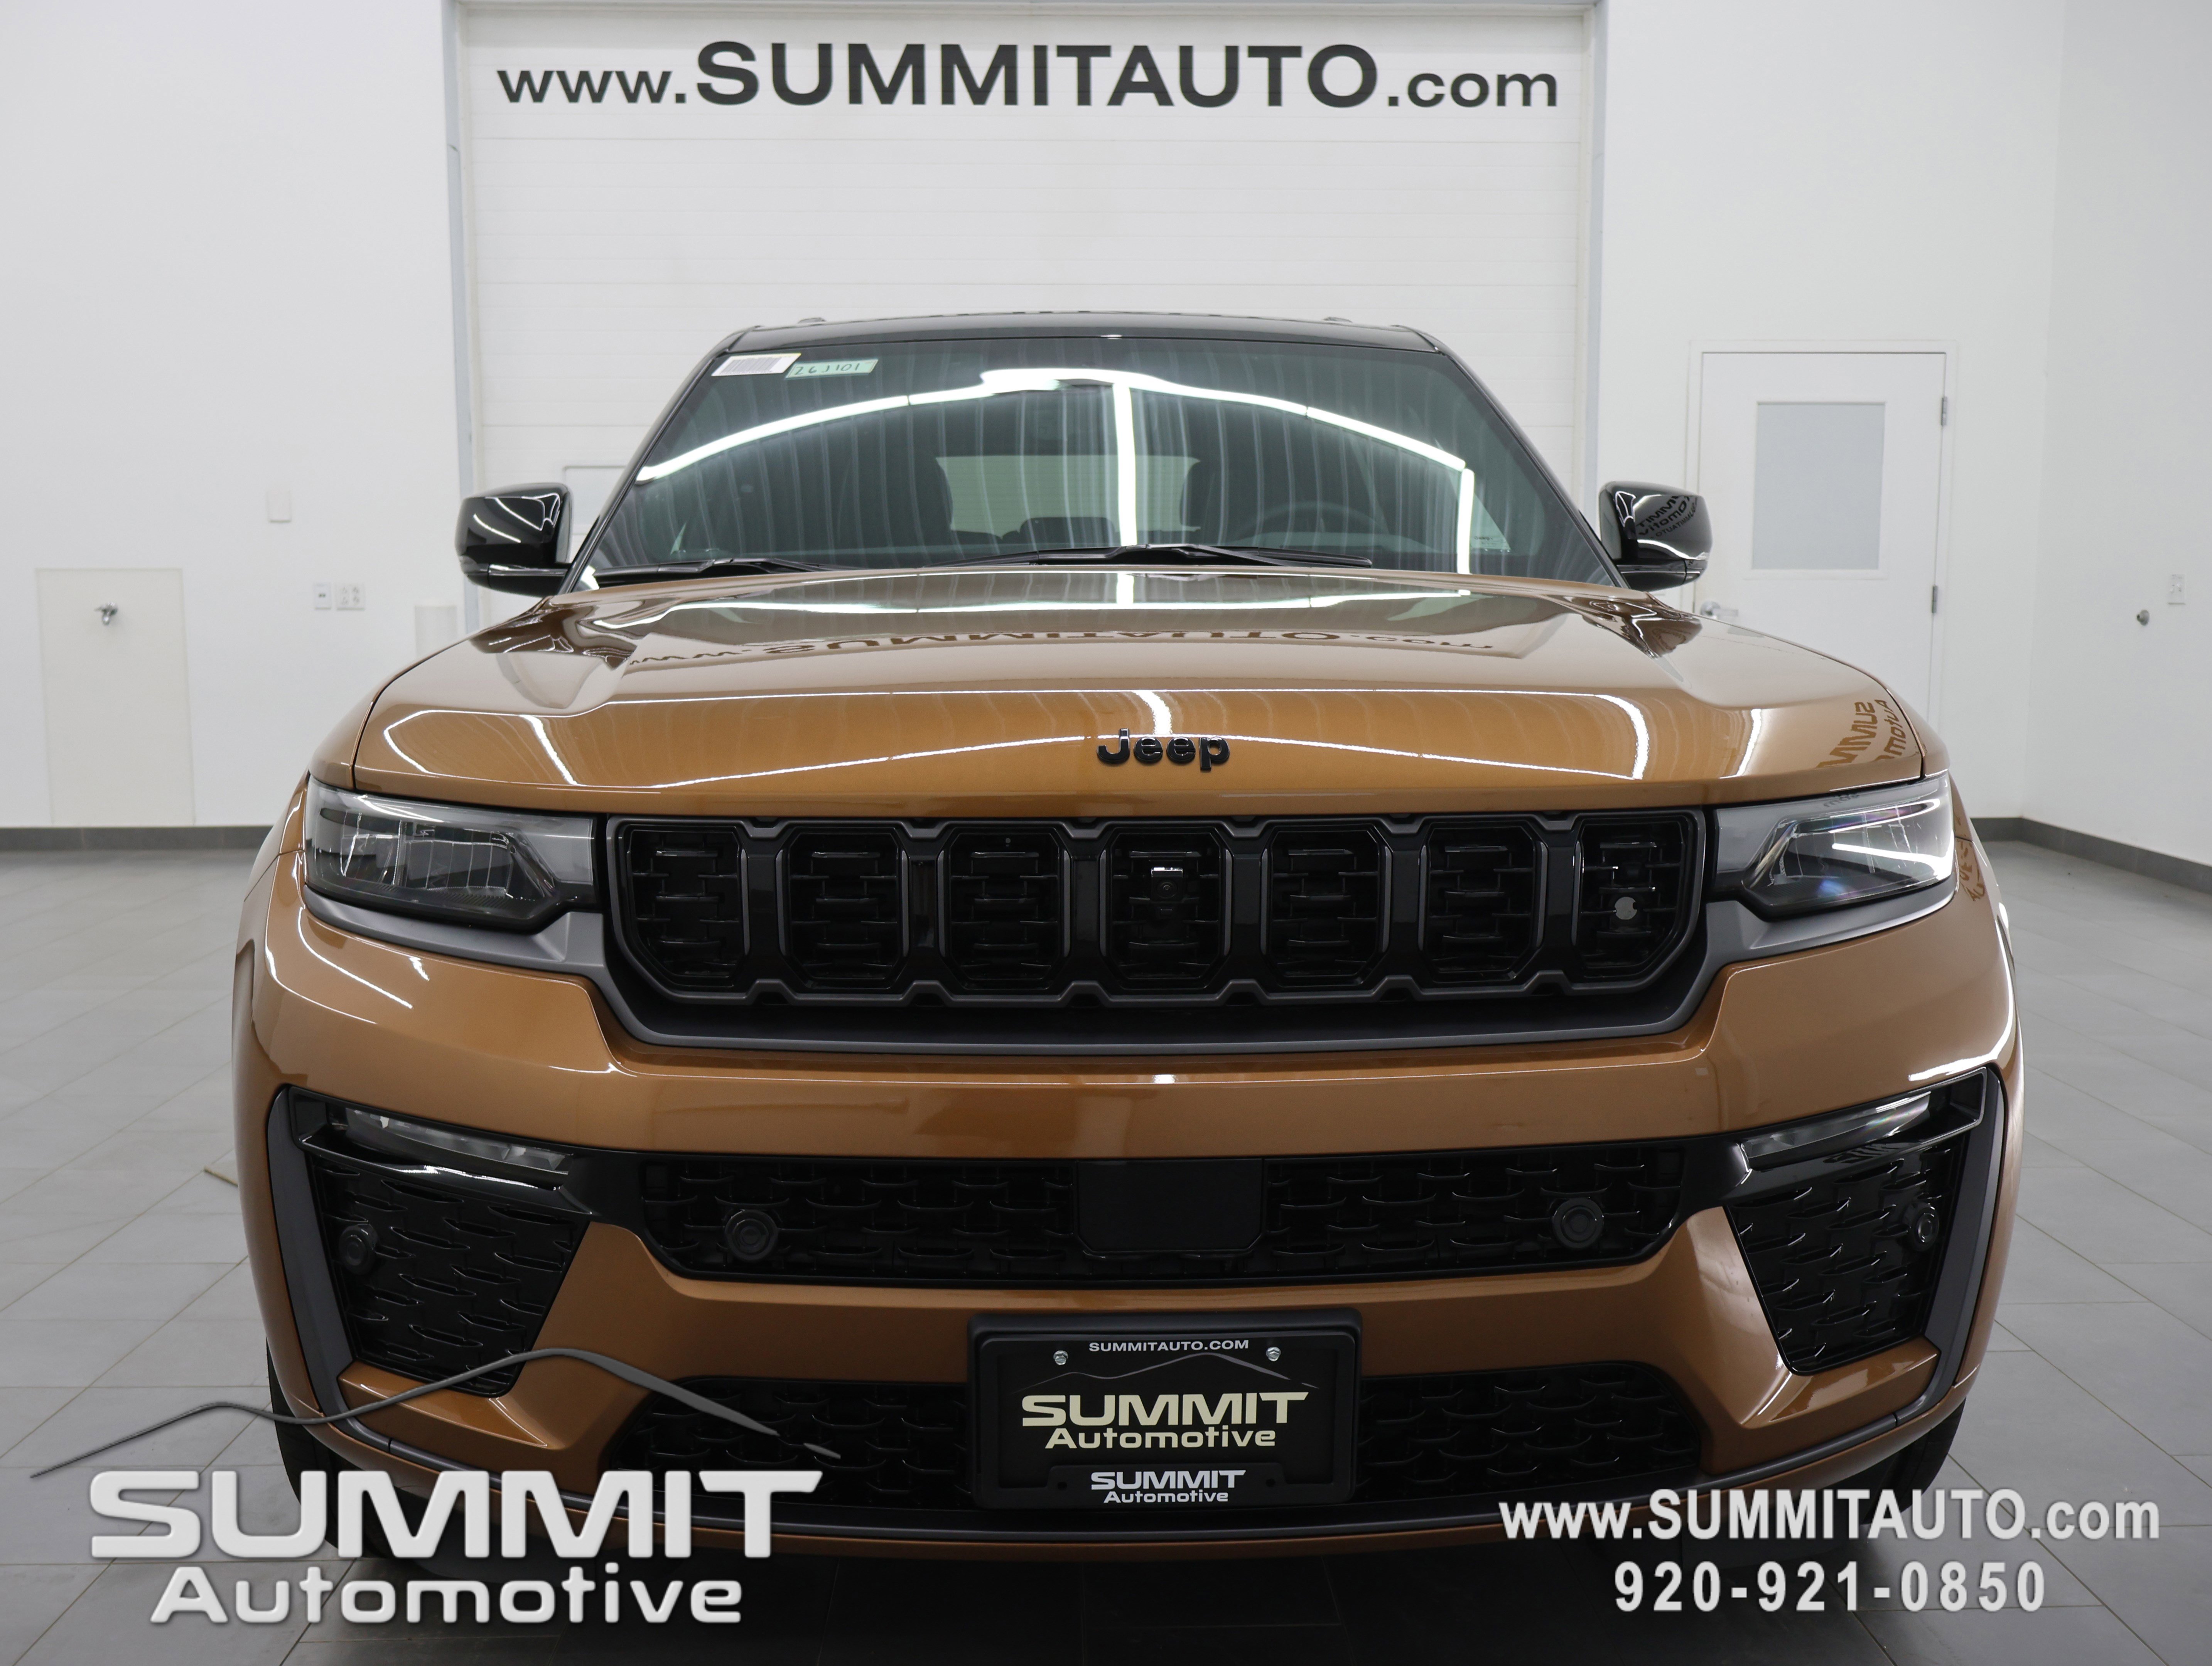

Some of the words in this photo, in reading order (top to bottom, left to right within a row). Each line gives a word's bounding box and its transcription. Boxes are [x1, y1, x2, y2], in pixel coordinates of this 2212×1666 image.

[496, 40, 1557, 108] www.SUMMITAUTO.com
[1097, 728, 1230, 771] Jeep
[1088, 1339, 1249, 1352] SUMMITAUTO.COM
[1022, 1392, 1309, 1427] SUMMIT
[1045, 1425, 1276, 1449] Automotive
[1091, 1470, 1246, 1490] SUMMIT
[1103, 1490, 1229, 1504] Automotive
